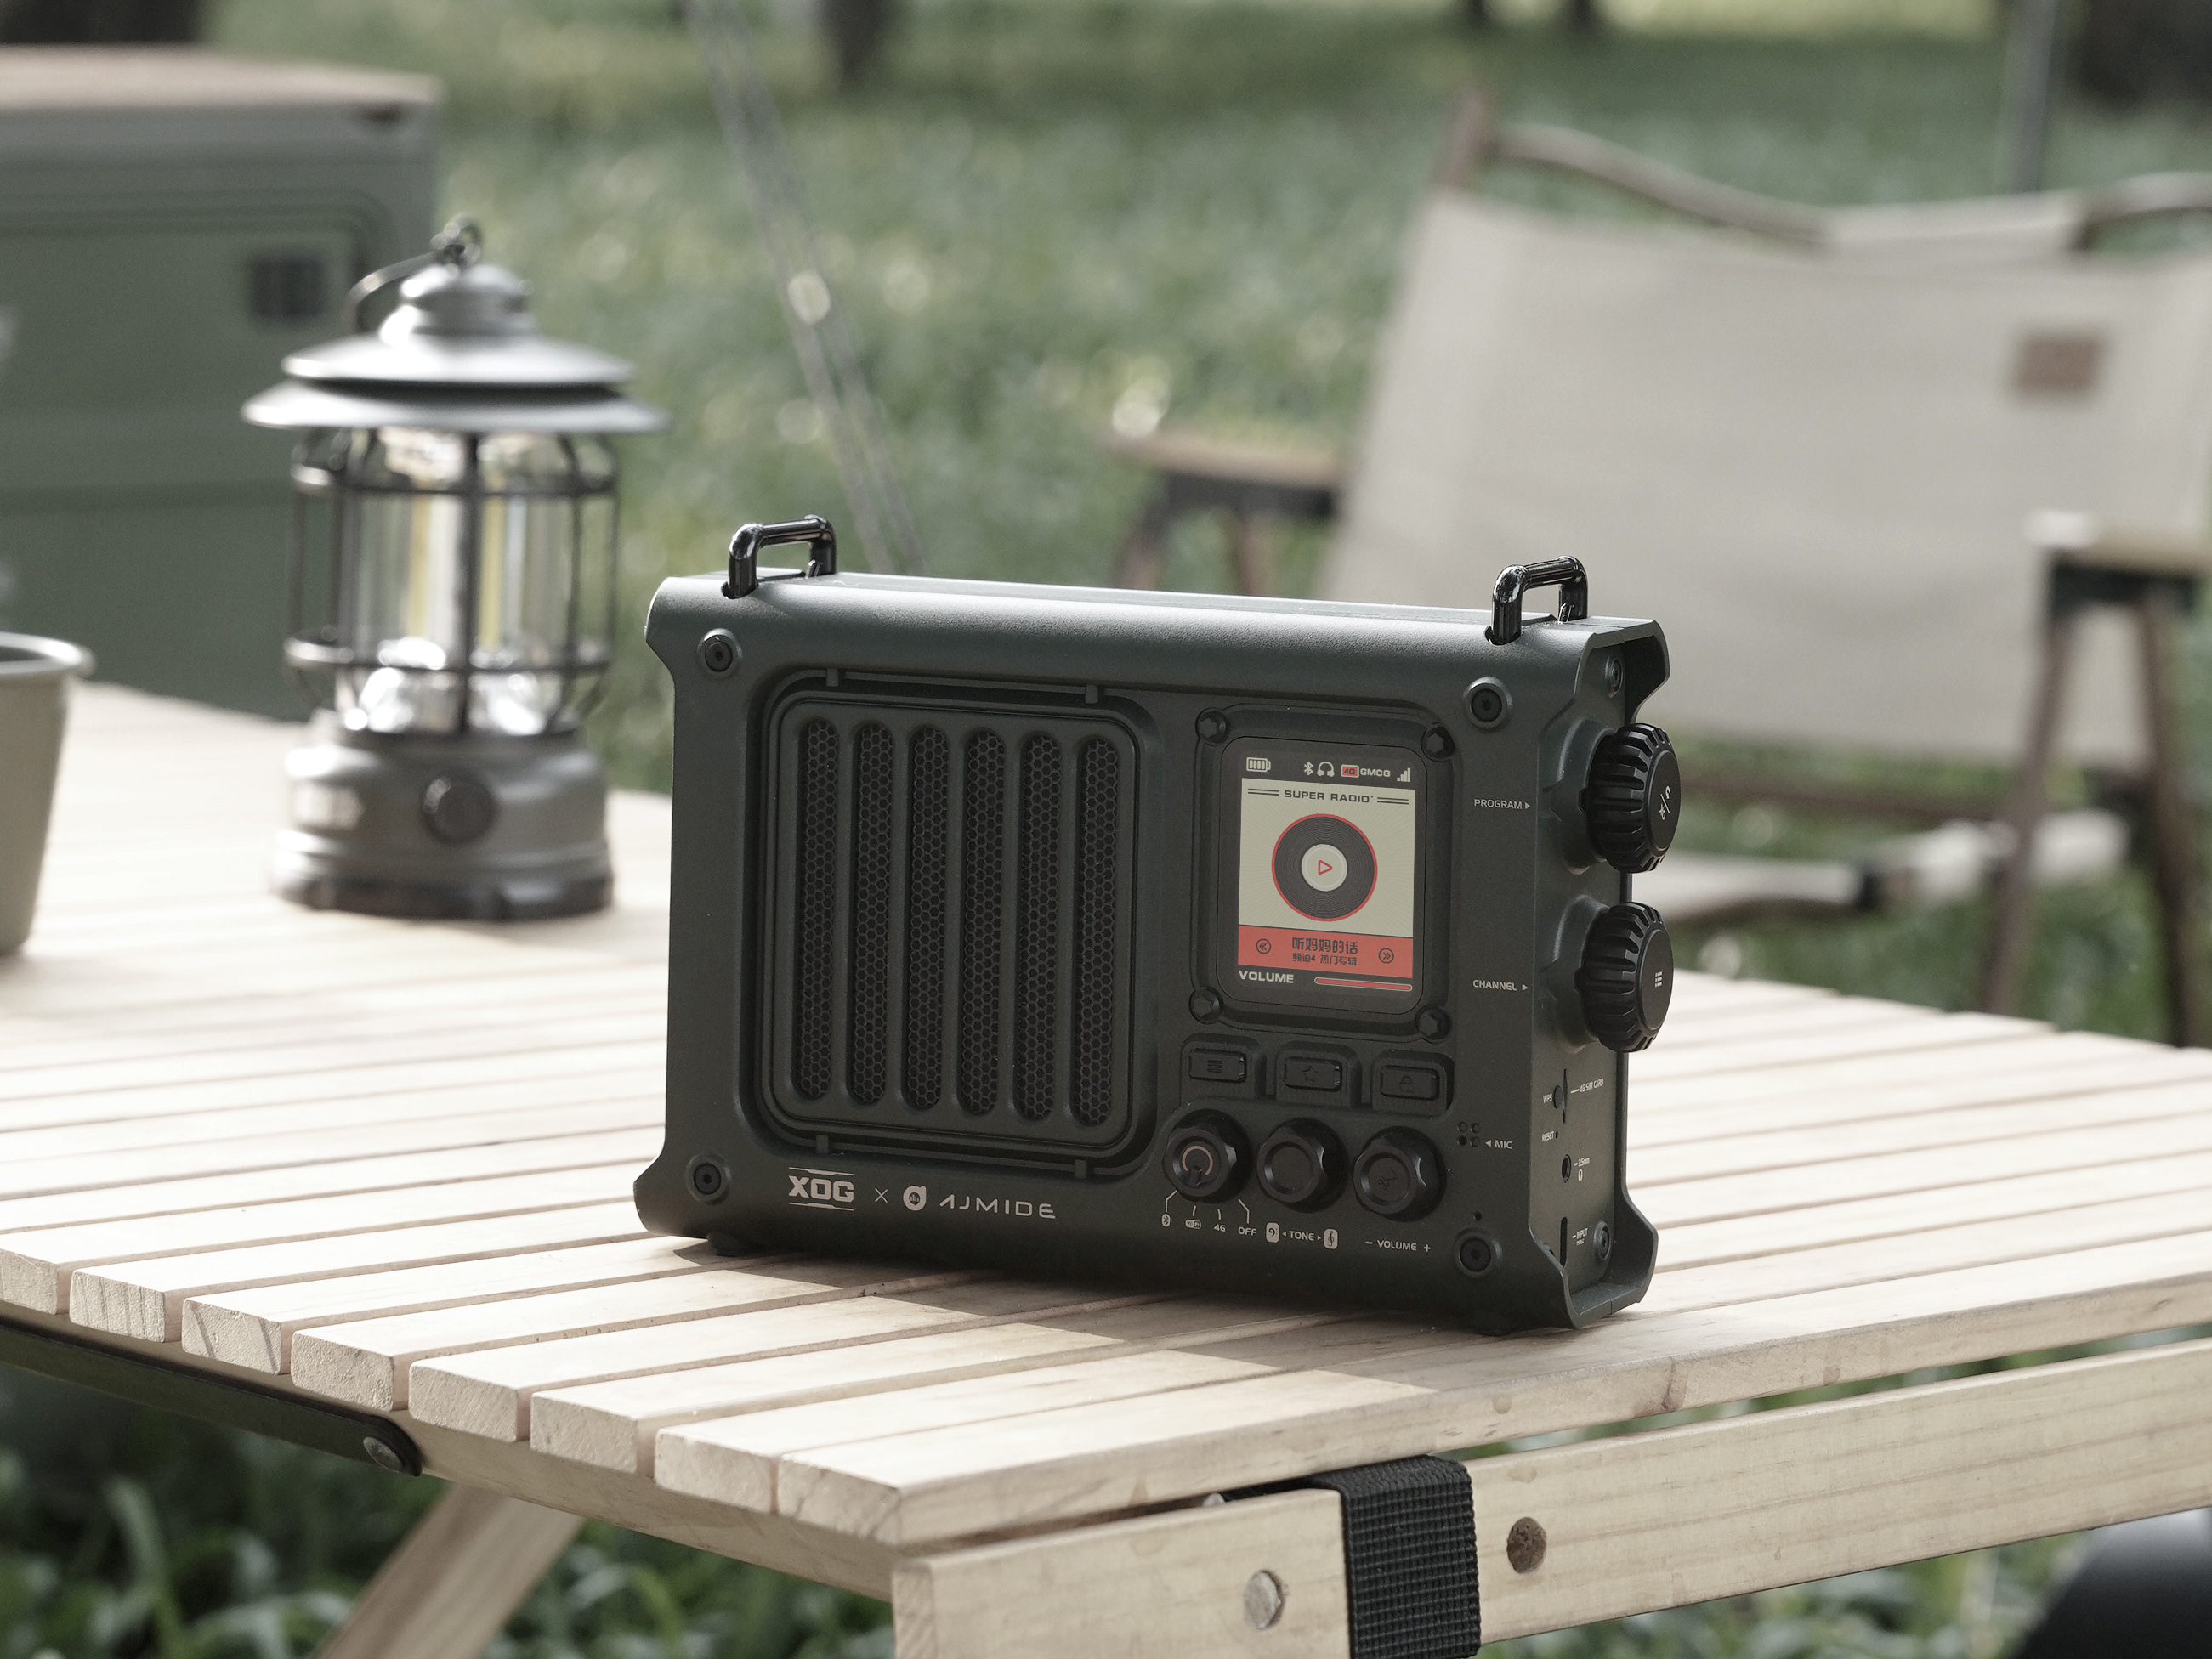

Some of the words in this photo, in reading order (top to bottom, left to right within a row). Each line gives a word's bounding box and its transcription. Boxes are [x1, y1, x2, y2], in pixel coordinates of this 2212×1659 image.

[1343, 767, 1356, 776] 4G
[1360, 767, 1391, 778] GMCG
[1284, 790, 1325, 801] SUPER
[1473, 798, 1523, 810] PROGRAM
[1292, 937, 1358, 954] 听妈妈的话
[1238, 970, 1294, 984] VOLUME
[1472, 979, 1517, 992] CHANNEL
[1541, 1130, 1555, 1142] RESET
[1495, 1140, 1513, 1150] MIC
[788, 1175, 854, 1203] XOG
[939, 1194, 1056, 1220] AJMIDE
[1213, 1224, 1227, 1232] 4G
[1238, 1226, 1257, 1237] OFF
[1289, 1230, 1315, 1242] TONE
[1376, 1239, 1417, 1251] VOLUME
